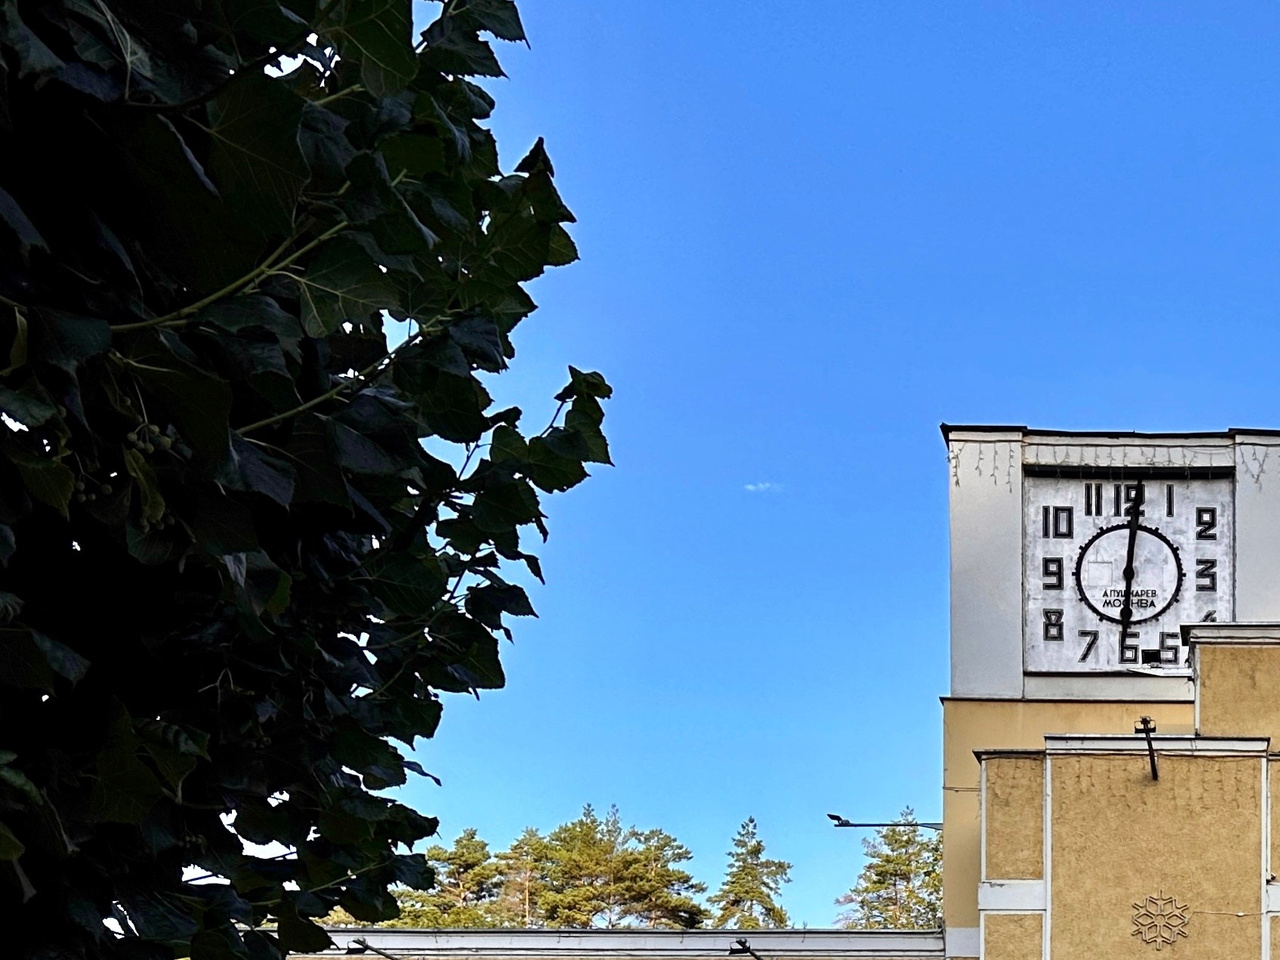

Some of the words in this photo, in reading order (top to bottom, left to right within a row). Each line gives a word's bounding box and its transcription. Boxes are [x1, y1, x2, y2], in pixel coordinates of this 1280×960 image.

[1085, 483, 1102, 516] 11
[1166, 484, 1174, 517] 1
[1042, 506, 1074, 539] 10
[1196, 507, 1217, 540] 2
[1042, 557, 1064, 590] 9
[1196, 559, 1217, 592] 3
[1043, 608, 1064, 641] 8
[1078, 630, 1099, 664] 7
[1118, 631, 1139, 664] 6
[1159, 631, 1180, 665] 5
